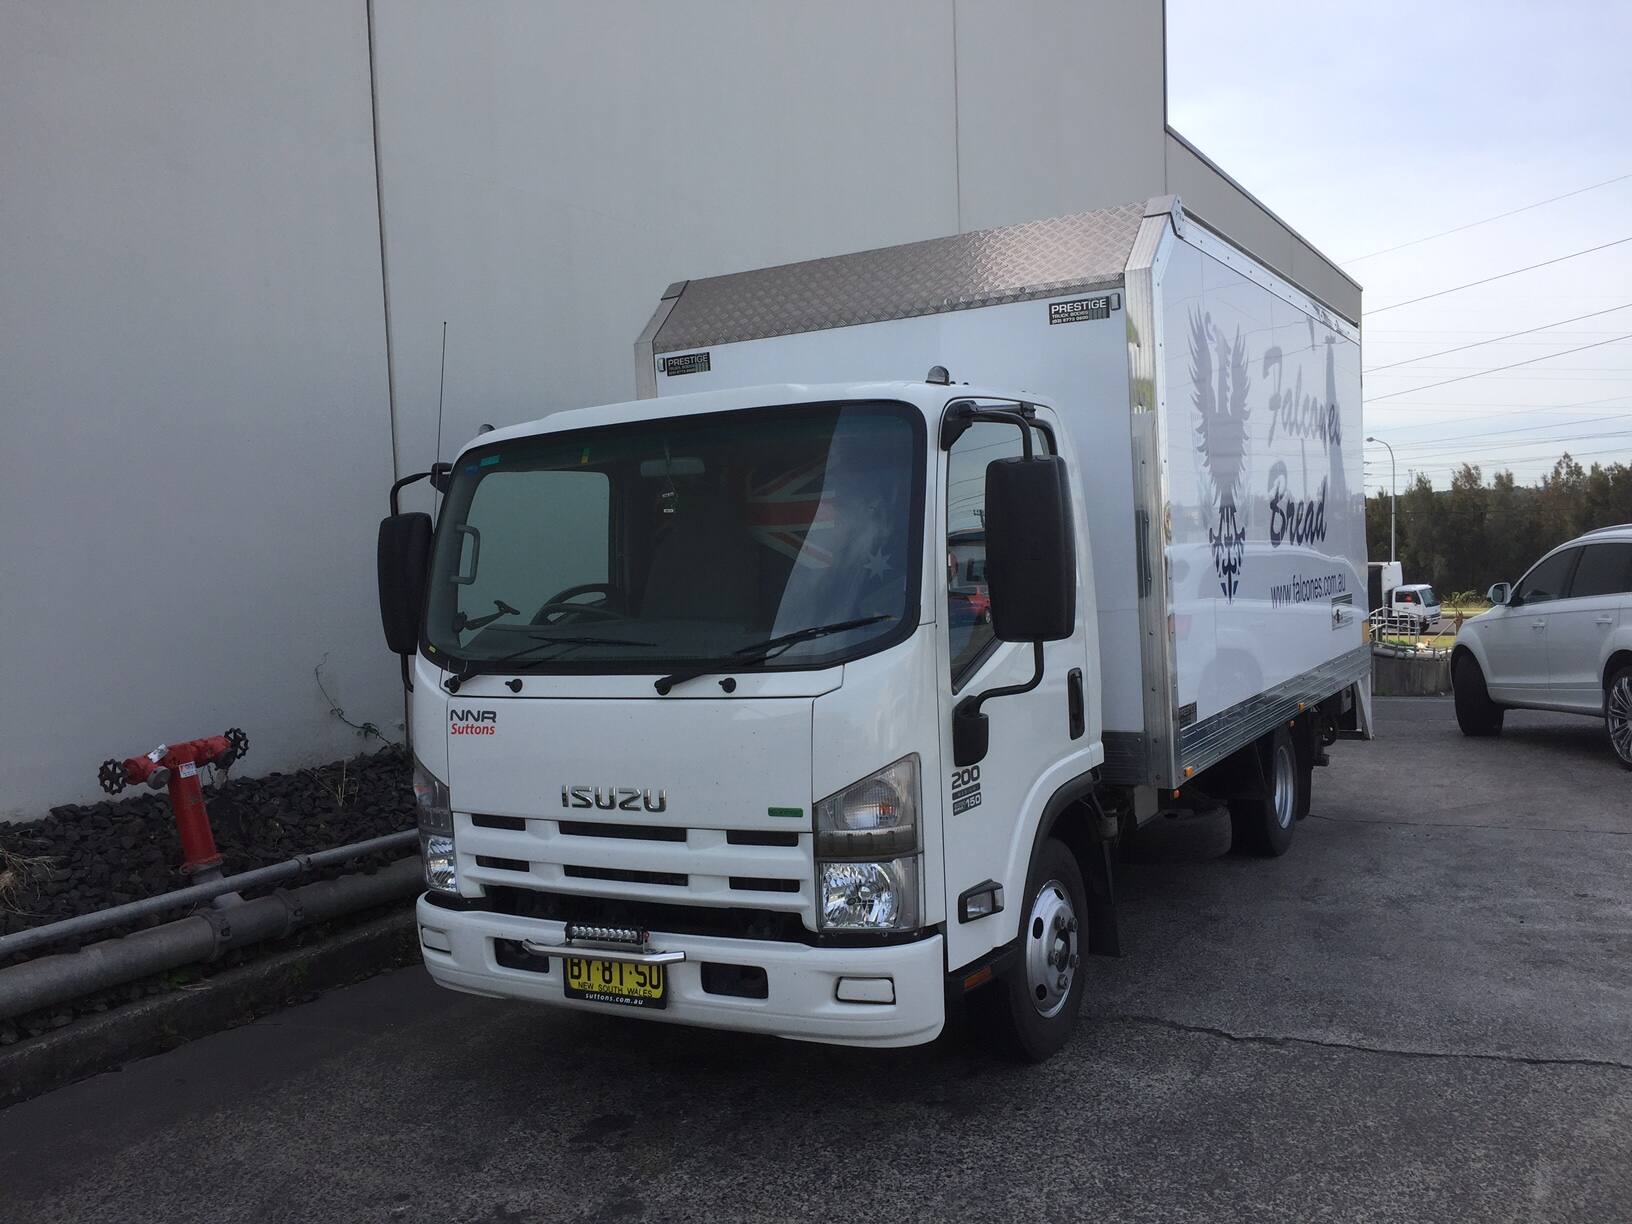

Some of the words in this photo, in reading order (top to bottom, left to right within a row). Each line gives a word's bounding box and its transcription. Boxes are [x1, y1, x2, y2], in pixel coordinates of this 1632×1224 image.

[1051, 299, 1107, 314] PRESTIGE
[668, 355, 708, 367] PRESTIGE
[1268, 461, 1327, 548] Bread
[1271, 573, 1346, 609] www.falcones.com.au
[450, 709, 497, 723] NNR
[451, 723, 496, 735] Suttons
[952, 765, 981, 790] 200
[562, 785, 667, 812] ISUZU
[966, 794, 981, 808] 150
[578, 981, 594, 990] NEW
[598, 984, 623, 995] SOUTH
[628, 987, 653, 998] WALES
[585, 992, 644, 1005] suttons.com.au
